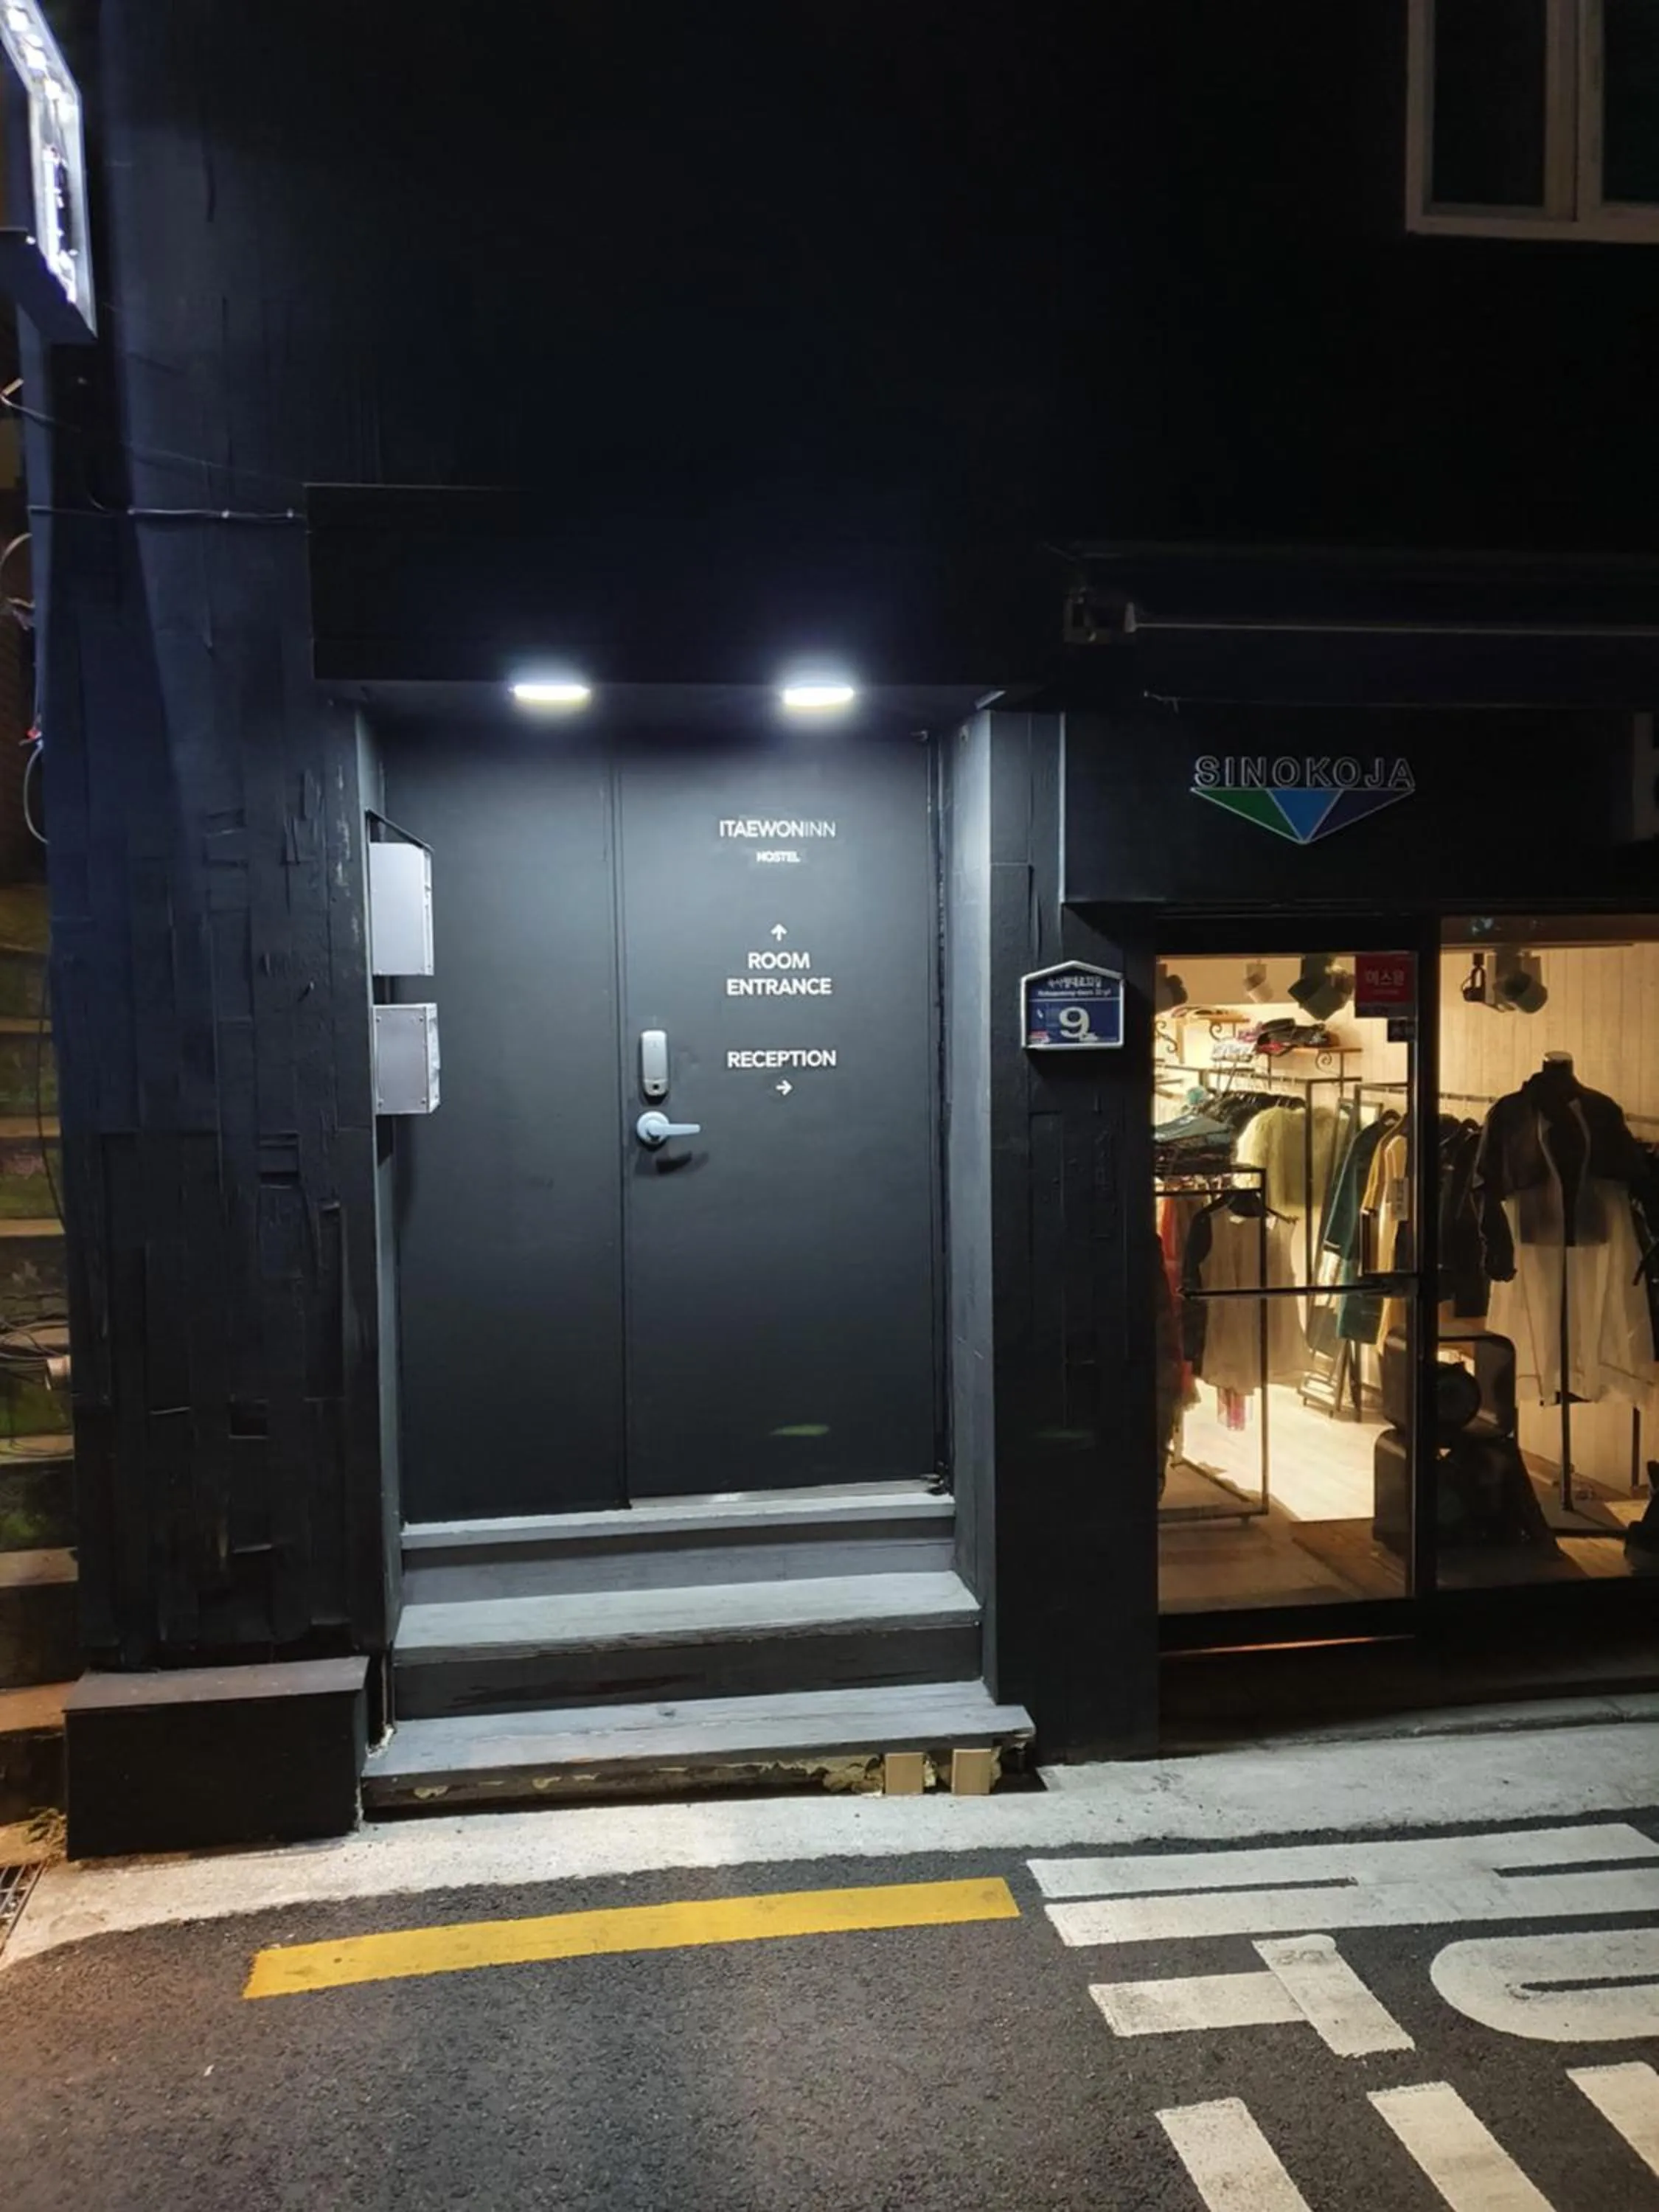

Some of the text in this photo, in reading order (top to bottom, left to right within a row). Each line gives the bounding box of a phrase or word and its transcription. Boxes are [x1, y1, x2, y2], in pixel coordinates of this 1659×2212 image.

[1194, 755, 1416, 788] SINOKOJA
[756, 850, 801, 863] HOSTEL
[748, 951, 810, 970] ROOM
[726, 978, 832, 996] ENTRANCE
[1059, 1006, 1090, 1039] 9
[727, 1049, 837, 1068] RECEPTION
